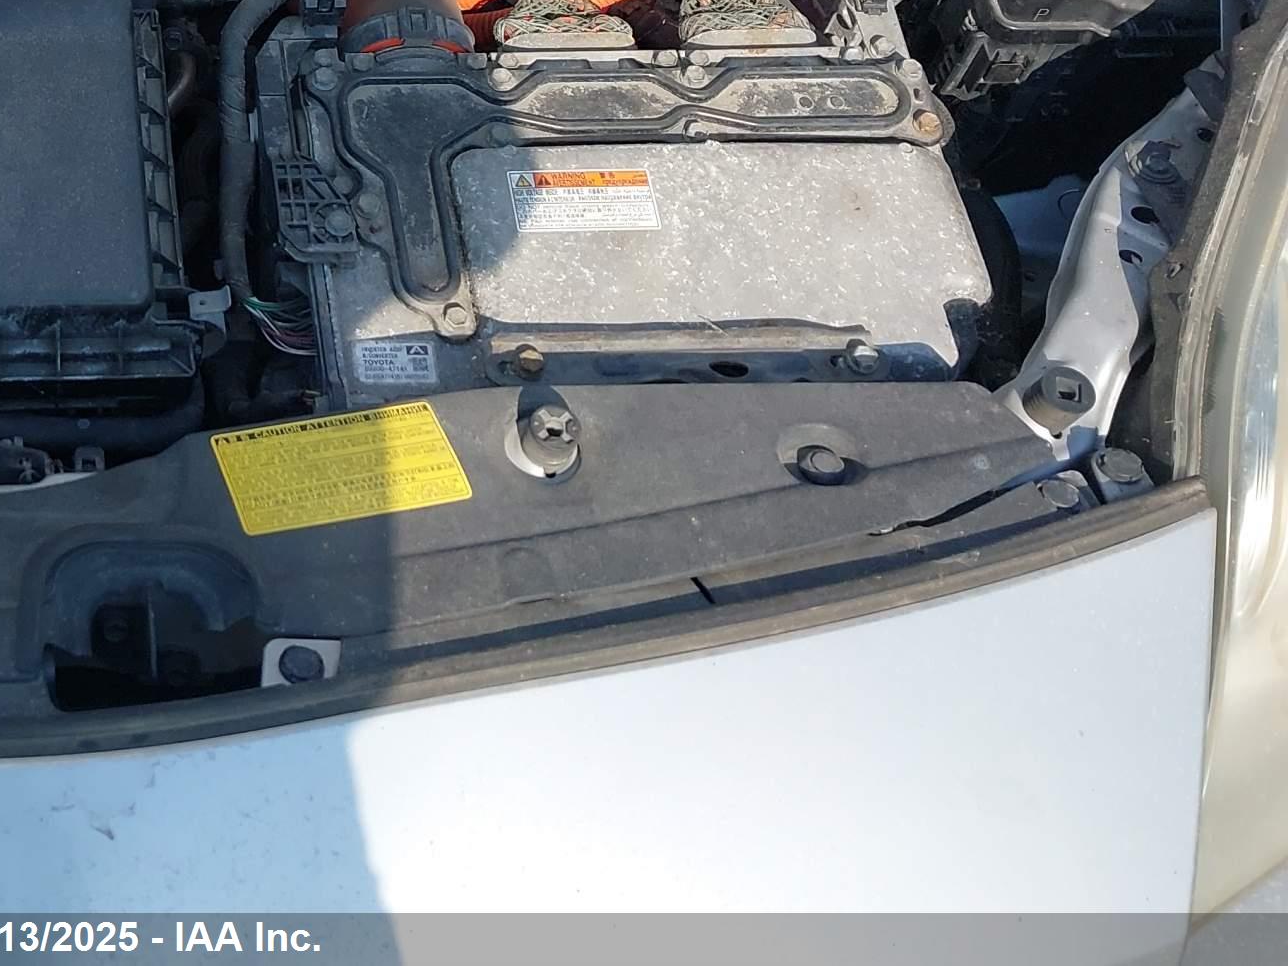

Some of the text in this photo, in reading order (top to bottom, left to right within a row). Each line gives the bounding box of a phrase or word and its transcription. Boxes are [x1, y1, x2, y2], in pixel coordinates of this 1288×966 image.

[551, 172, 586, 180] WARNING
[255, 425, 301, 439] CAUTION
[306, 412, 364, 431] ATTENTION
